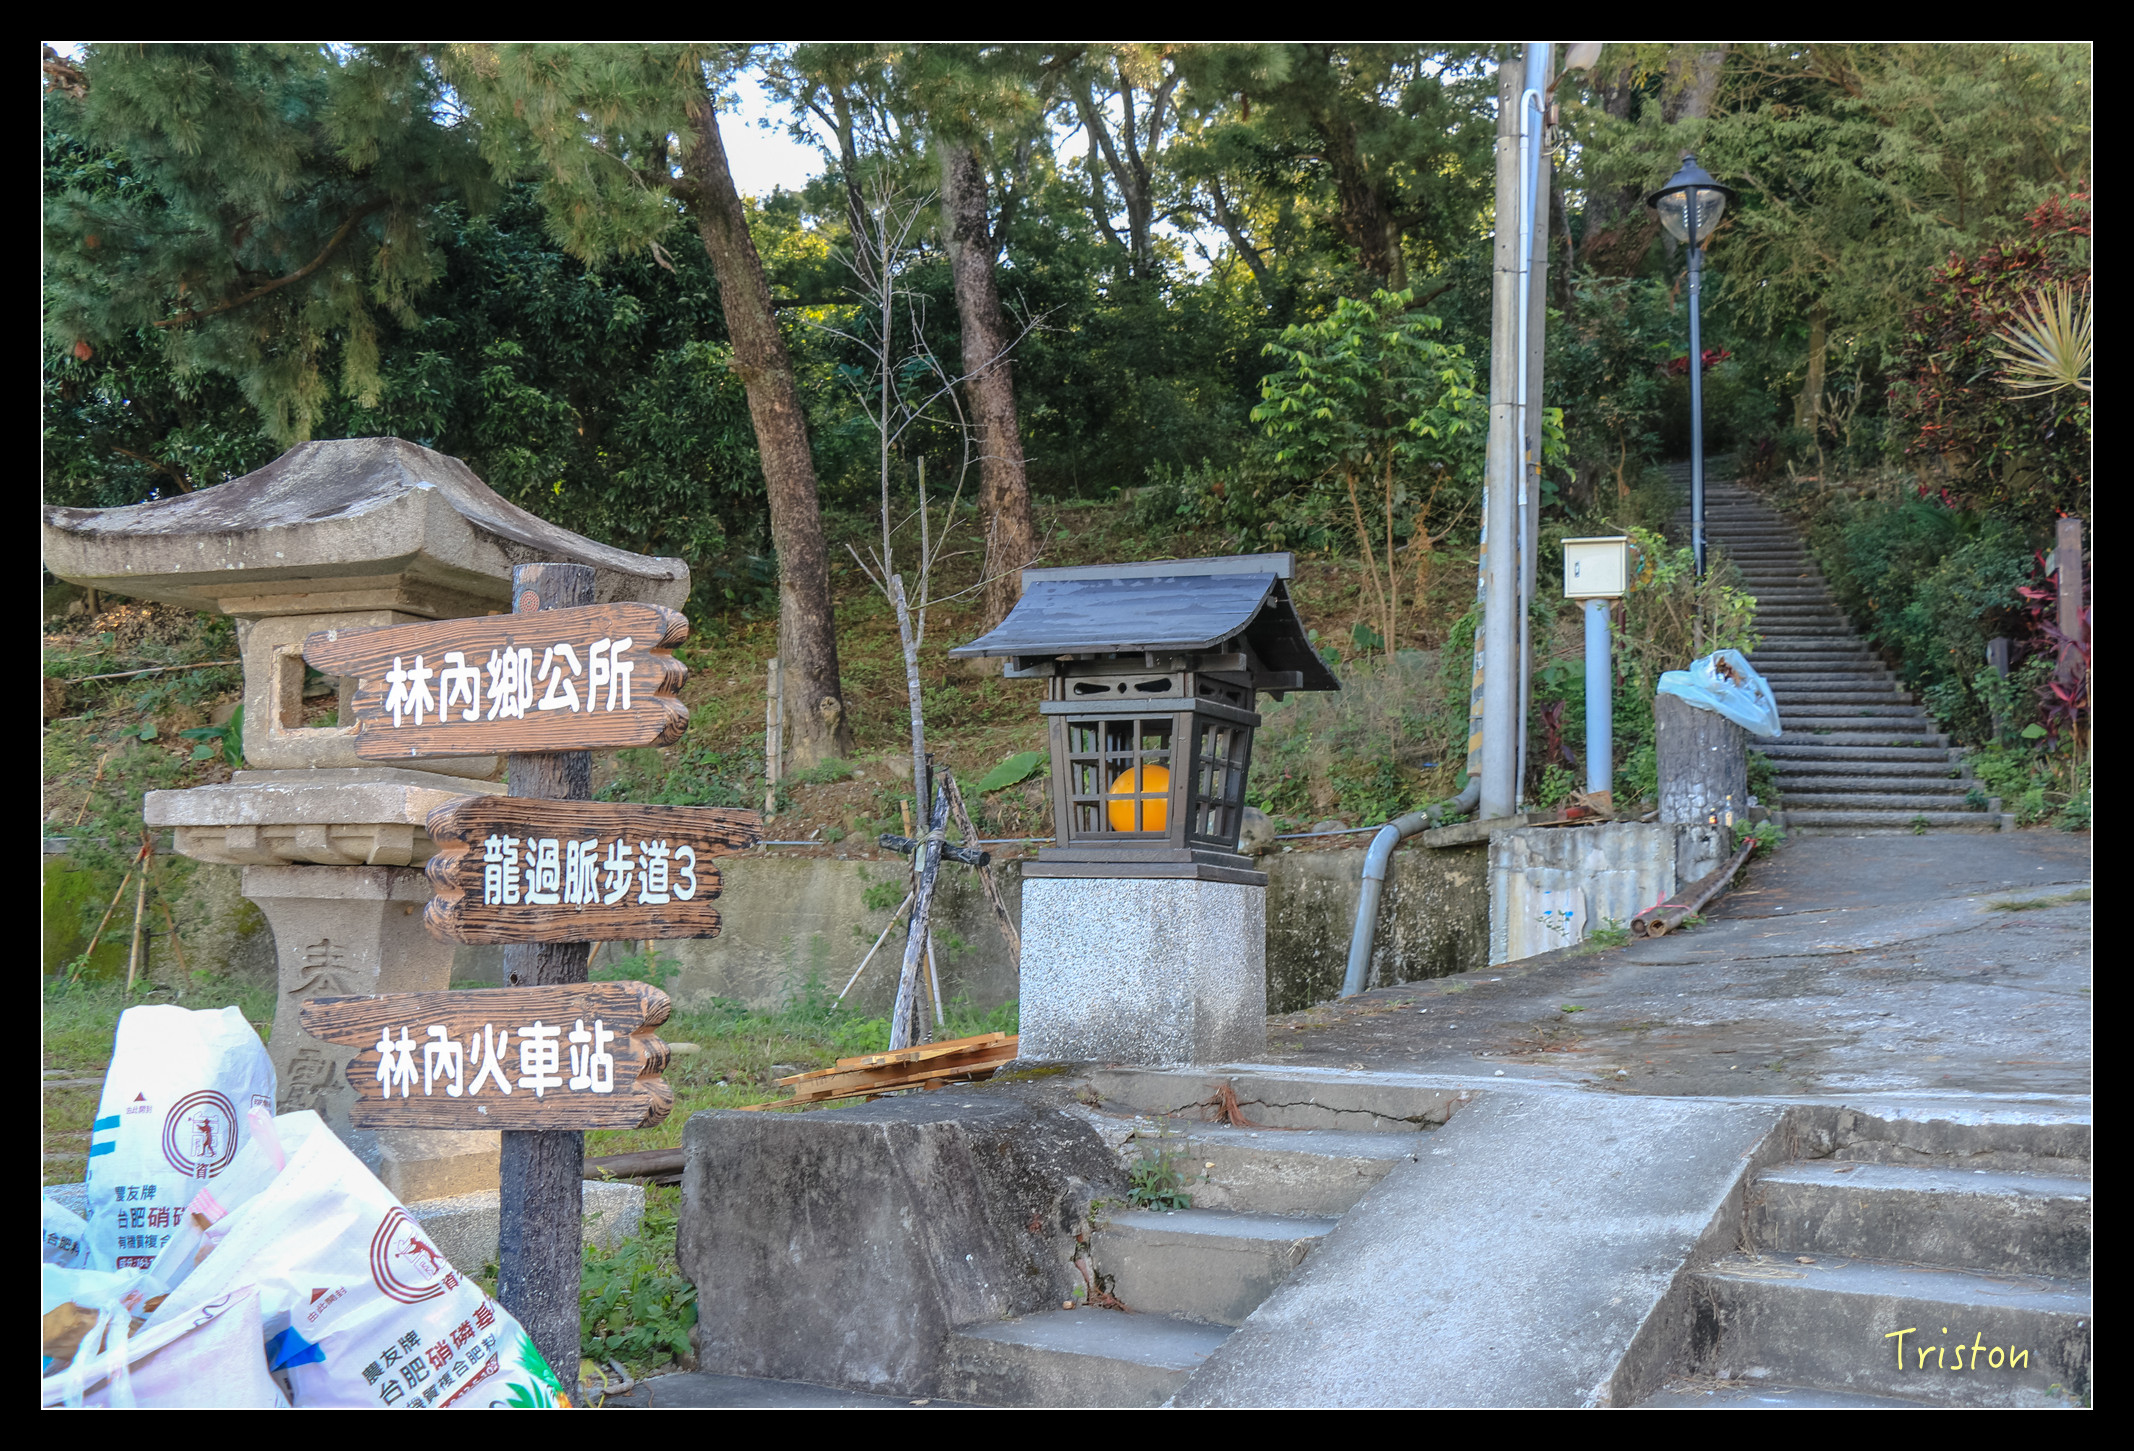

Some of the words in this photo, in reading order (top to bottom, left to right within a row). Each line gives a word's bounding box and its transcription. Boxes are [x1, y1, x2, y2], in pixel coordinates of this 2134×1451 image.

[385, 636, 635, 729] 林內鄉公所
[483, 833, 697, 906] 龍過脈步道3
[376, 1018, 615, 1099] 林內火車站
